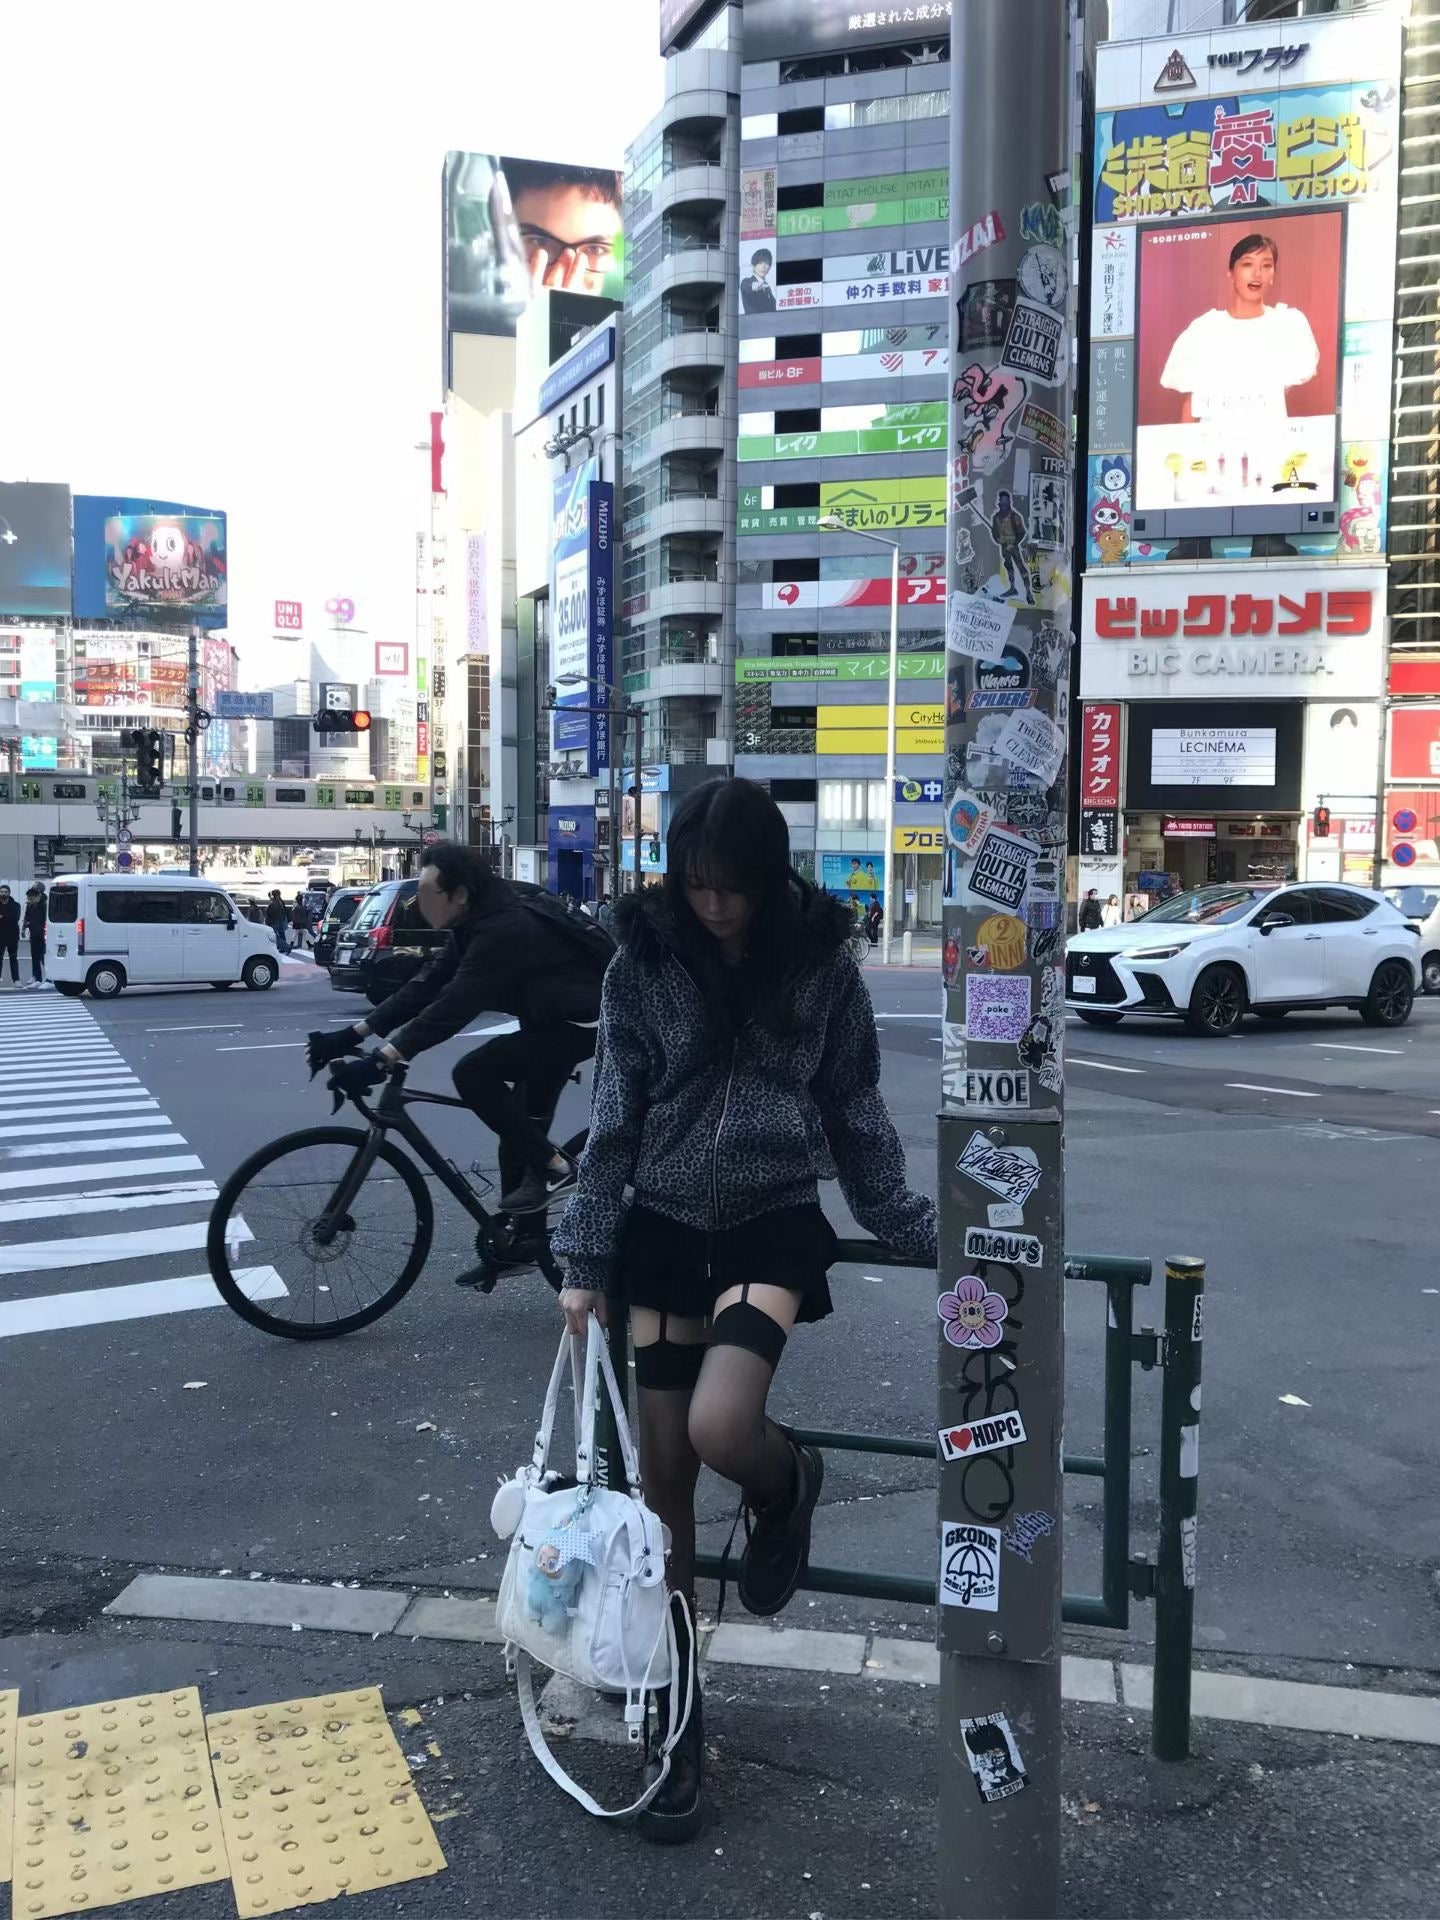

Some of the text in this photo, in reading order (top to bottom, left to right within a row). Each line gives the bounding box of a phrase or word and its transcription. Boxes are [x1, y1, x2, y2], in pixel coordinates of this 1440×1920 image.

[826, 186, 854, 200] PITAT
[858, 183, 898, 198] HOUSE
[906, 178, 935, 192] PITAT
[1112, 188, 1213, 218] SHIBUYA
[1231, 183, 1257, 205] AI
[787, 287, 811, 297] 全国の
[846, 280, 922, 300] 仲介手数料
[778, 296, 820, 308] お部屋探し
[1016, 308, 1061, 338] STRAIGHT
[1011, 325, 1056, 359] OUTTA
[1009, 346, 1051, 374] CLEMENS
[786, 367, 803, 378] 8F
[775, 435, 818, 453] レイク
[897, 427, 942, 445] レイク
[743, 493, 757, 506] 6F
[598, 500, 608, 550] MIZUHO
[768, 516, 788, 527] 売買
[276, 603, 298, 616] UNI
[1095, 591, 1373, 639] ビックカメラ
[276, 615, 300, 628] QLO
[970, 613, 1001, 633] LEGEND
[846, 658, 945, 677] マインドフル
[1128, 648, 1334, 676] BIC CAMERA
[745, 732, 761, 746] 3F
[1180, 729, 1248, 737] Bunkamura
[1089, 712, 1112, 794] カラオケ
[558, 820, 576, 832] MIZUHO
[979, 852, 1027, 888] OUTTA
[975, 875, 1019, 902] CLEMENS
[970, 1416, 1021, 1448] HDPC
[945, 1526, 998, 1556] GKODE
